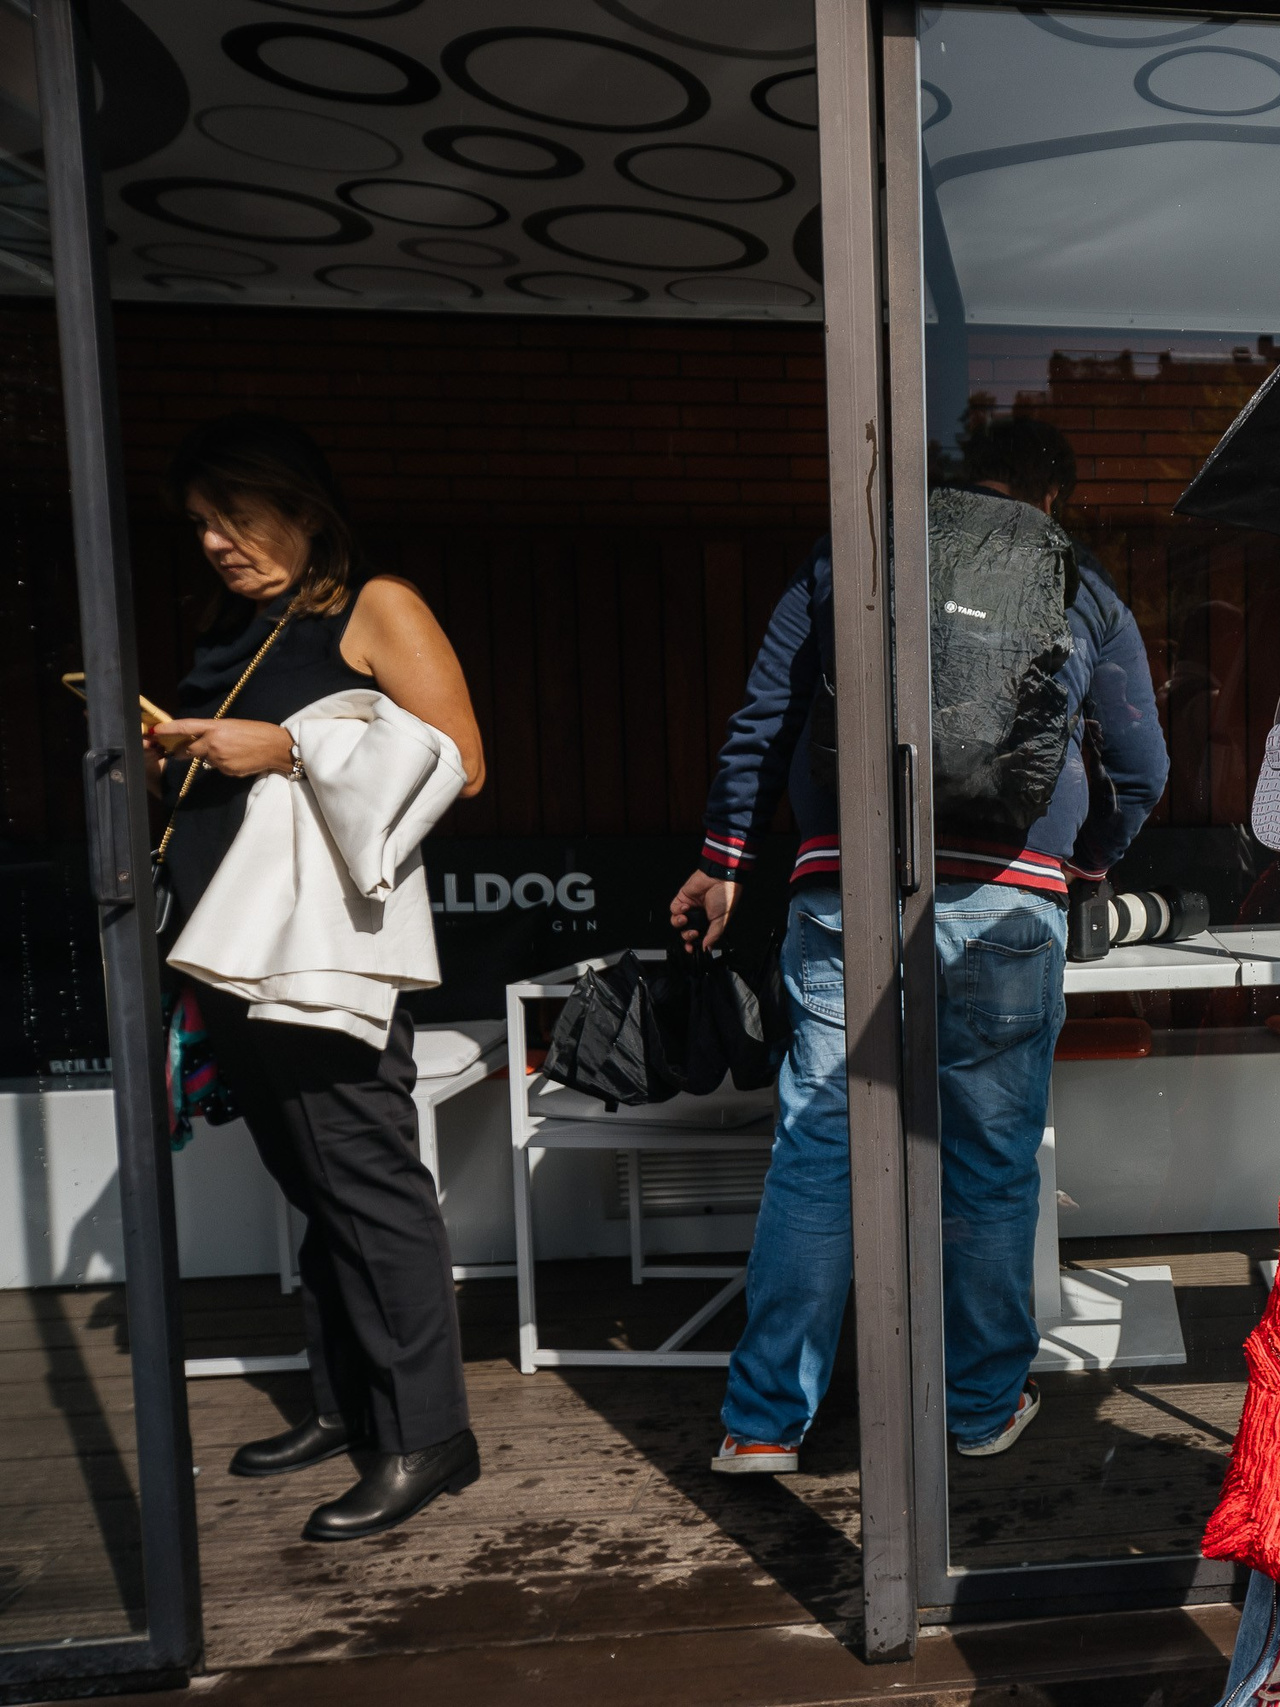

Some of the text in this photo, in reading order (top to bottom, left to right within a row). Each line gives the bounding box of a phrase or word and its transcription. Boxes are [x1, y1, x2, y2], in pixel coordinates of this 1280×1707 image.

[957, 605, 987, 619] TARION
[431, 871, 596, 912] LDOG
[551, 919, 598, 932] GIN
